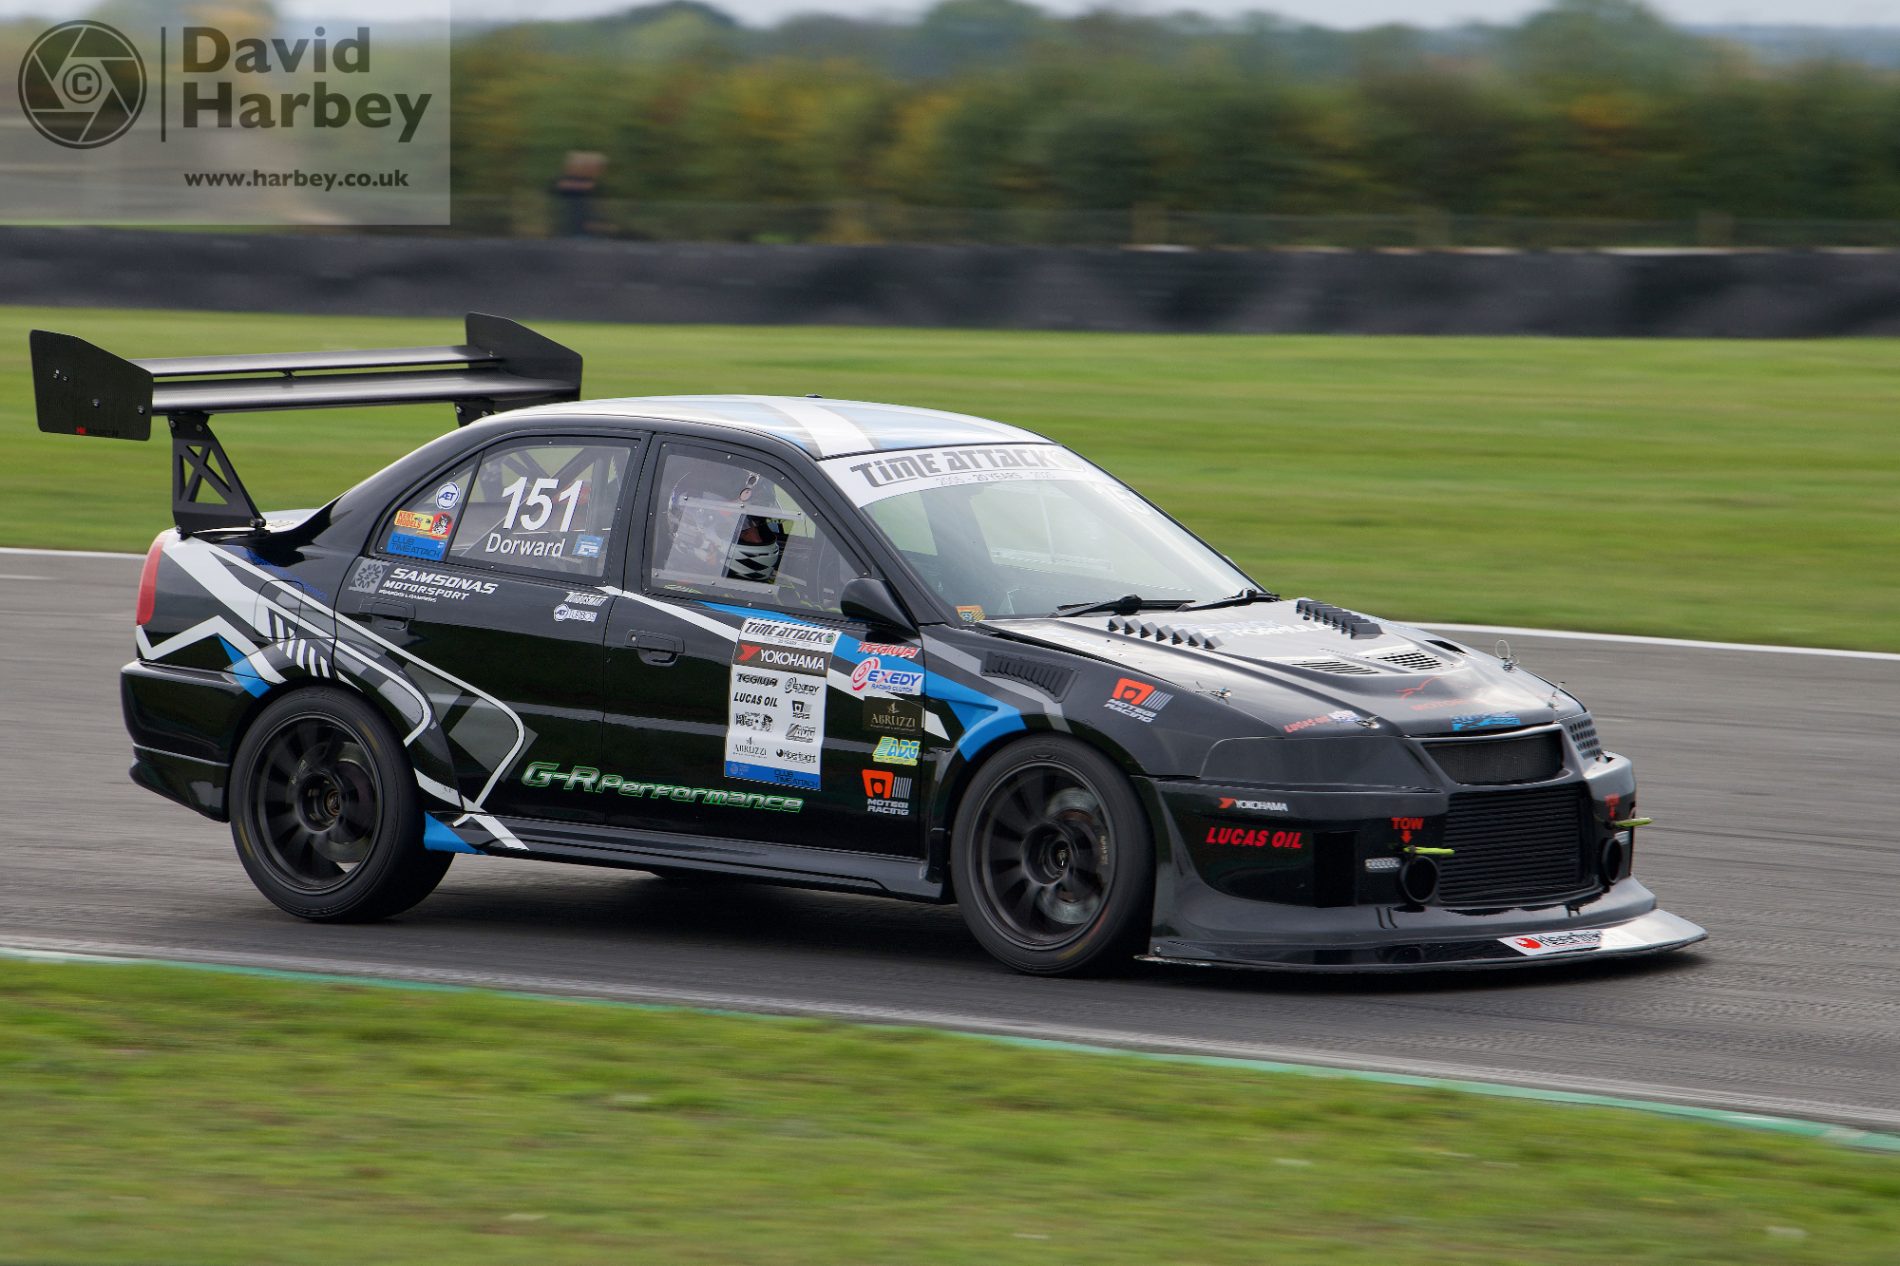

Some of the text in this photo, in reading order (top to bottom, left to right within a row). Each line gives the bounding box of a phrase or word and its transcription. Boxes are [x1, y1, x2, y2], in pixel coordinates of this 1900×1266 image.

[502, 477, 583, 532] 151
[485, 533, 565, 557] Dorward
[383, 579, 470, 601] MOTORSPORT
[390, 567, 499, 595] SAMSONAS
[760, 649, 825, 671] YOKOHAMA
[867, 669, 922, 687] EXEDY
[793, 682, 820, 693] EXEDY
[733, 692, 778, 708] LUCAS OIL
[871, 712, 916, 728] ABRUZZI
[867, 805, 910, 816] RACING
[1235, 799, 1288, 811] YOKOHAMA
[1391, 817, 1425, 830] TOW
[1205, 827, 1303, 849] LUCAS OIL
